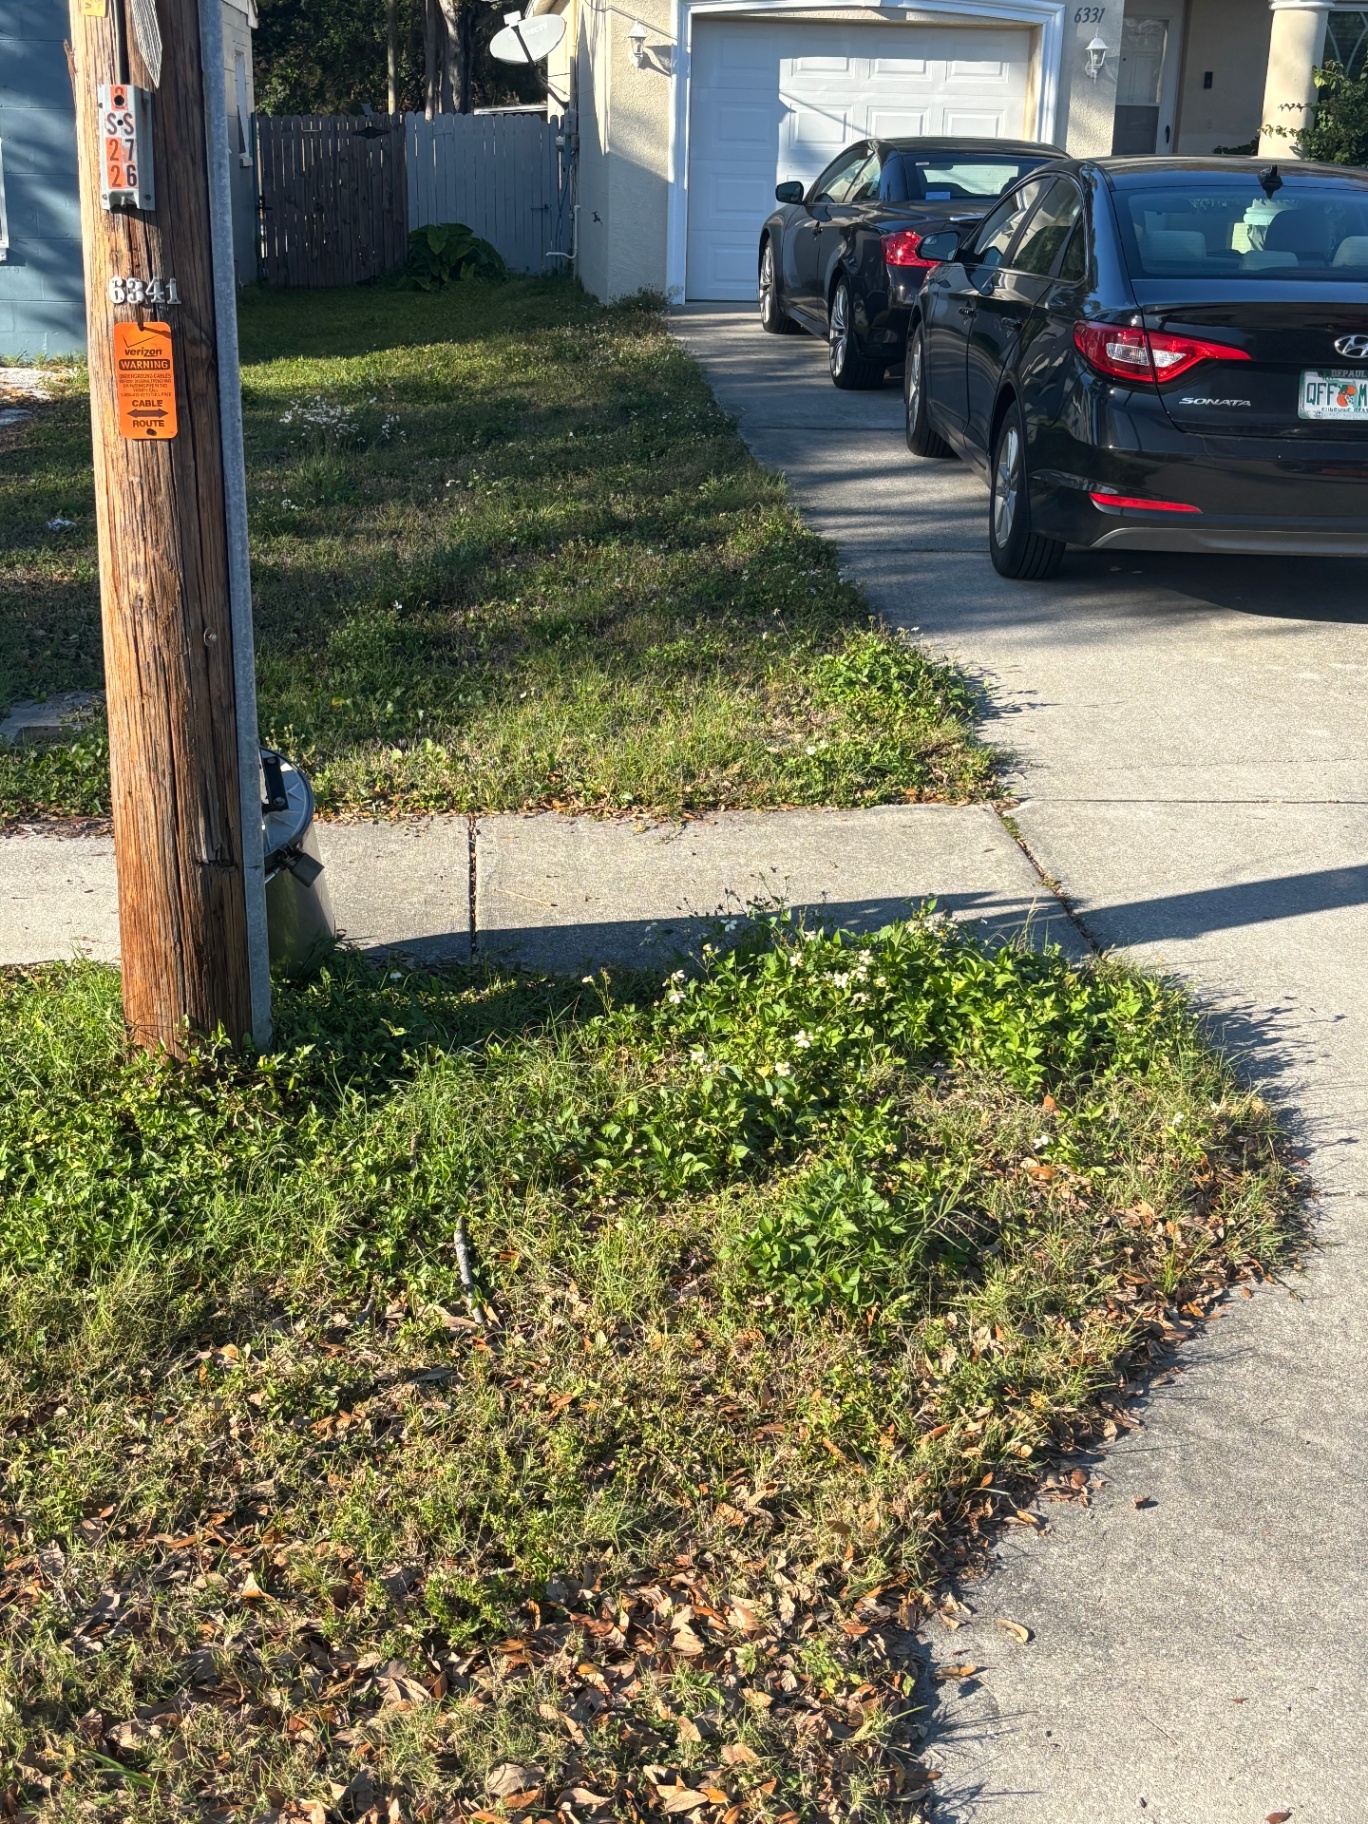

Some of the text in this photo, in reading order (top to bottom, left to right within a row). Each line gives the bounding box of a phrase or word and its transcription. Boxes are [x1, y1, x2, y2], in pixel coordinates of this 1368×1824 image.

[1074, 7, 1105, 23] 6331
[109, 276, 182, 304] 6341
[124, 347, 162, 357] verizon
[121, 361, 168, 369] WARNING
[1331, 369, 1367, 378] DEPAUL
[1306, 383, 1338, 406] QFF
[1178, 397, 1252, 407] SONATA
